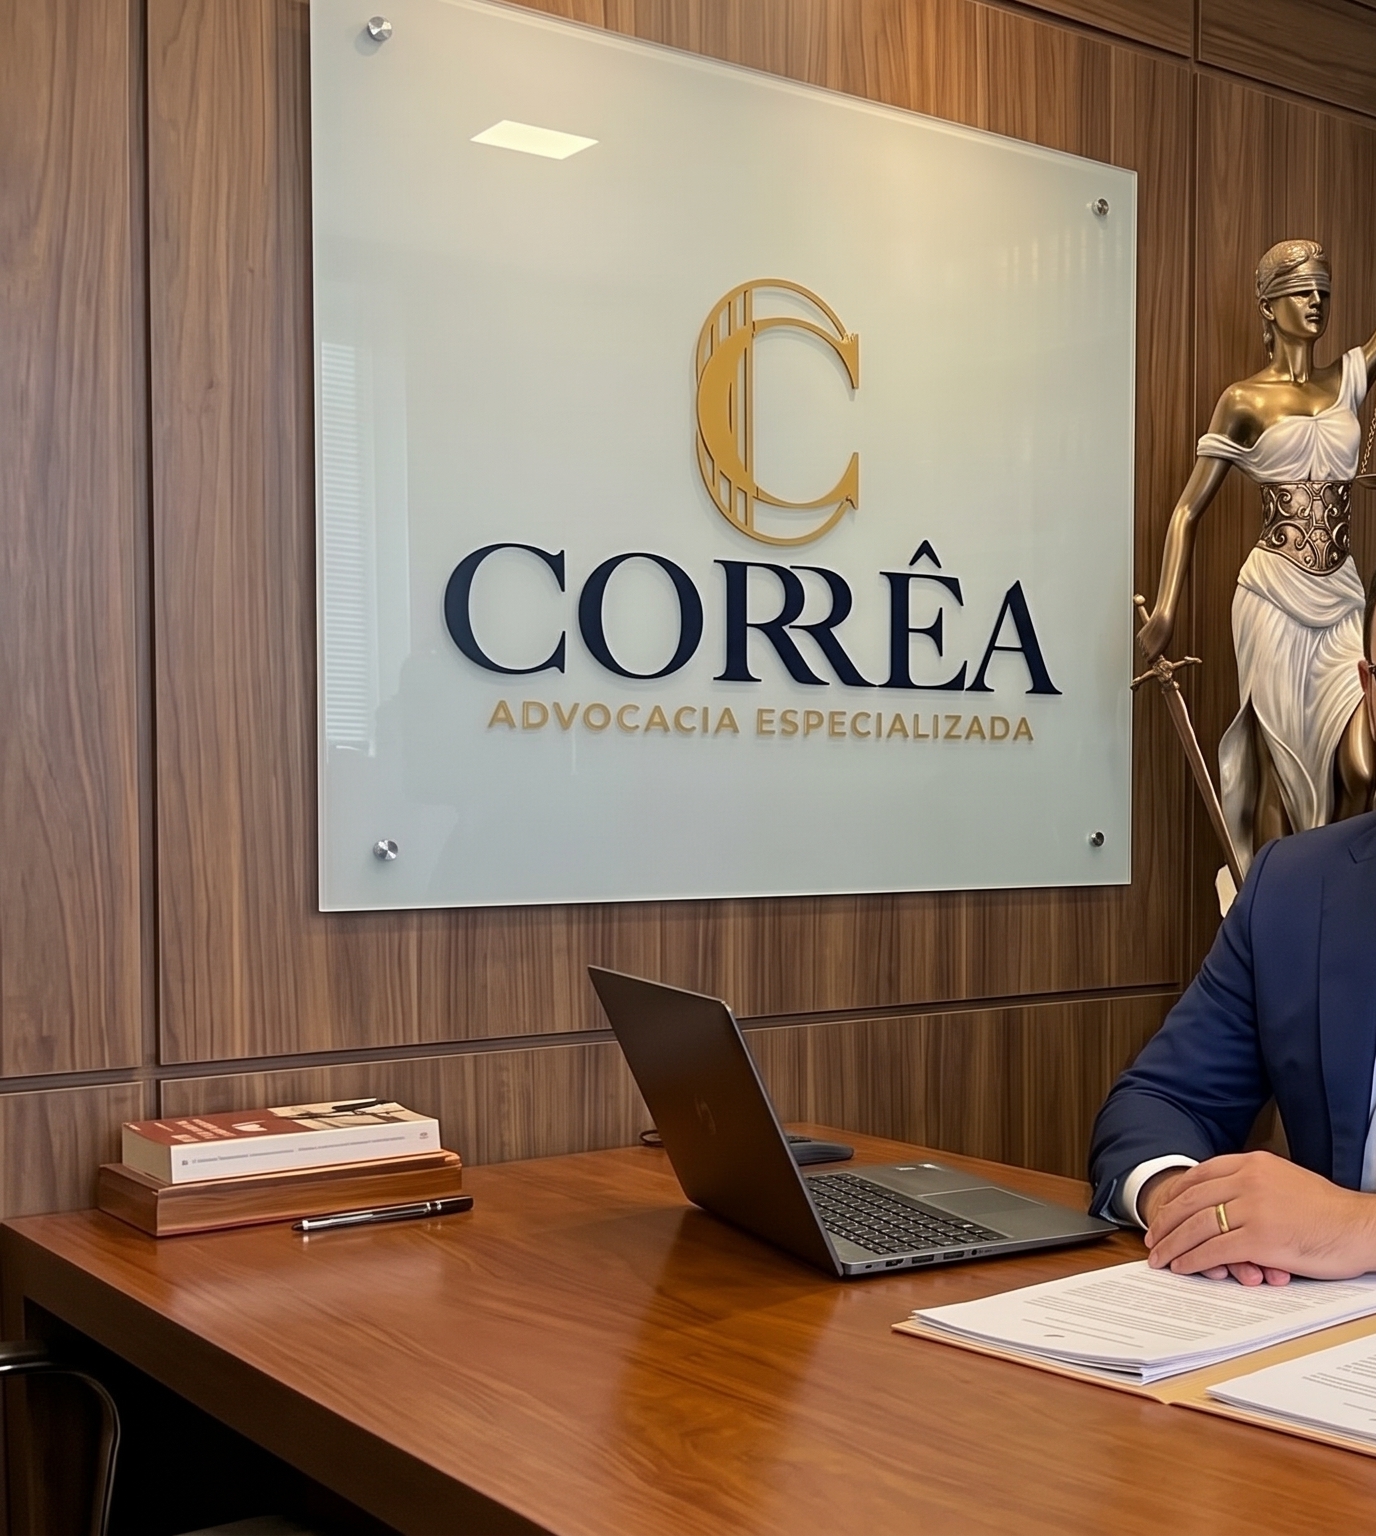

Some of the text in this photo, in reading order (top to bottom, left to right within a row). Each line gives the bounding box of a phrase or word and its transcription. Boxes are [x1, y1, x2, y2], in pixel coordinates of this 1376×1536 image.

[444, 540, 1062, 695] CORRÊA
[488, 699, 1034, 742] ADVOCACIA ESPECIALIZADA
